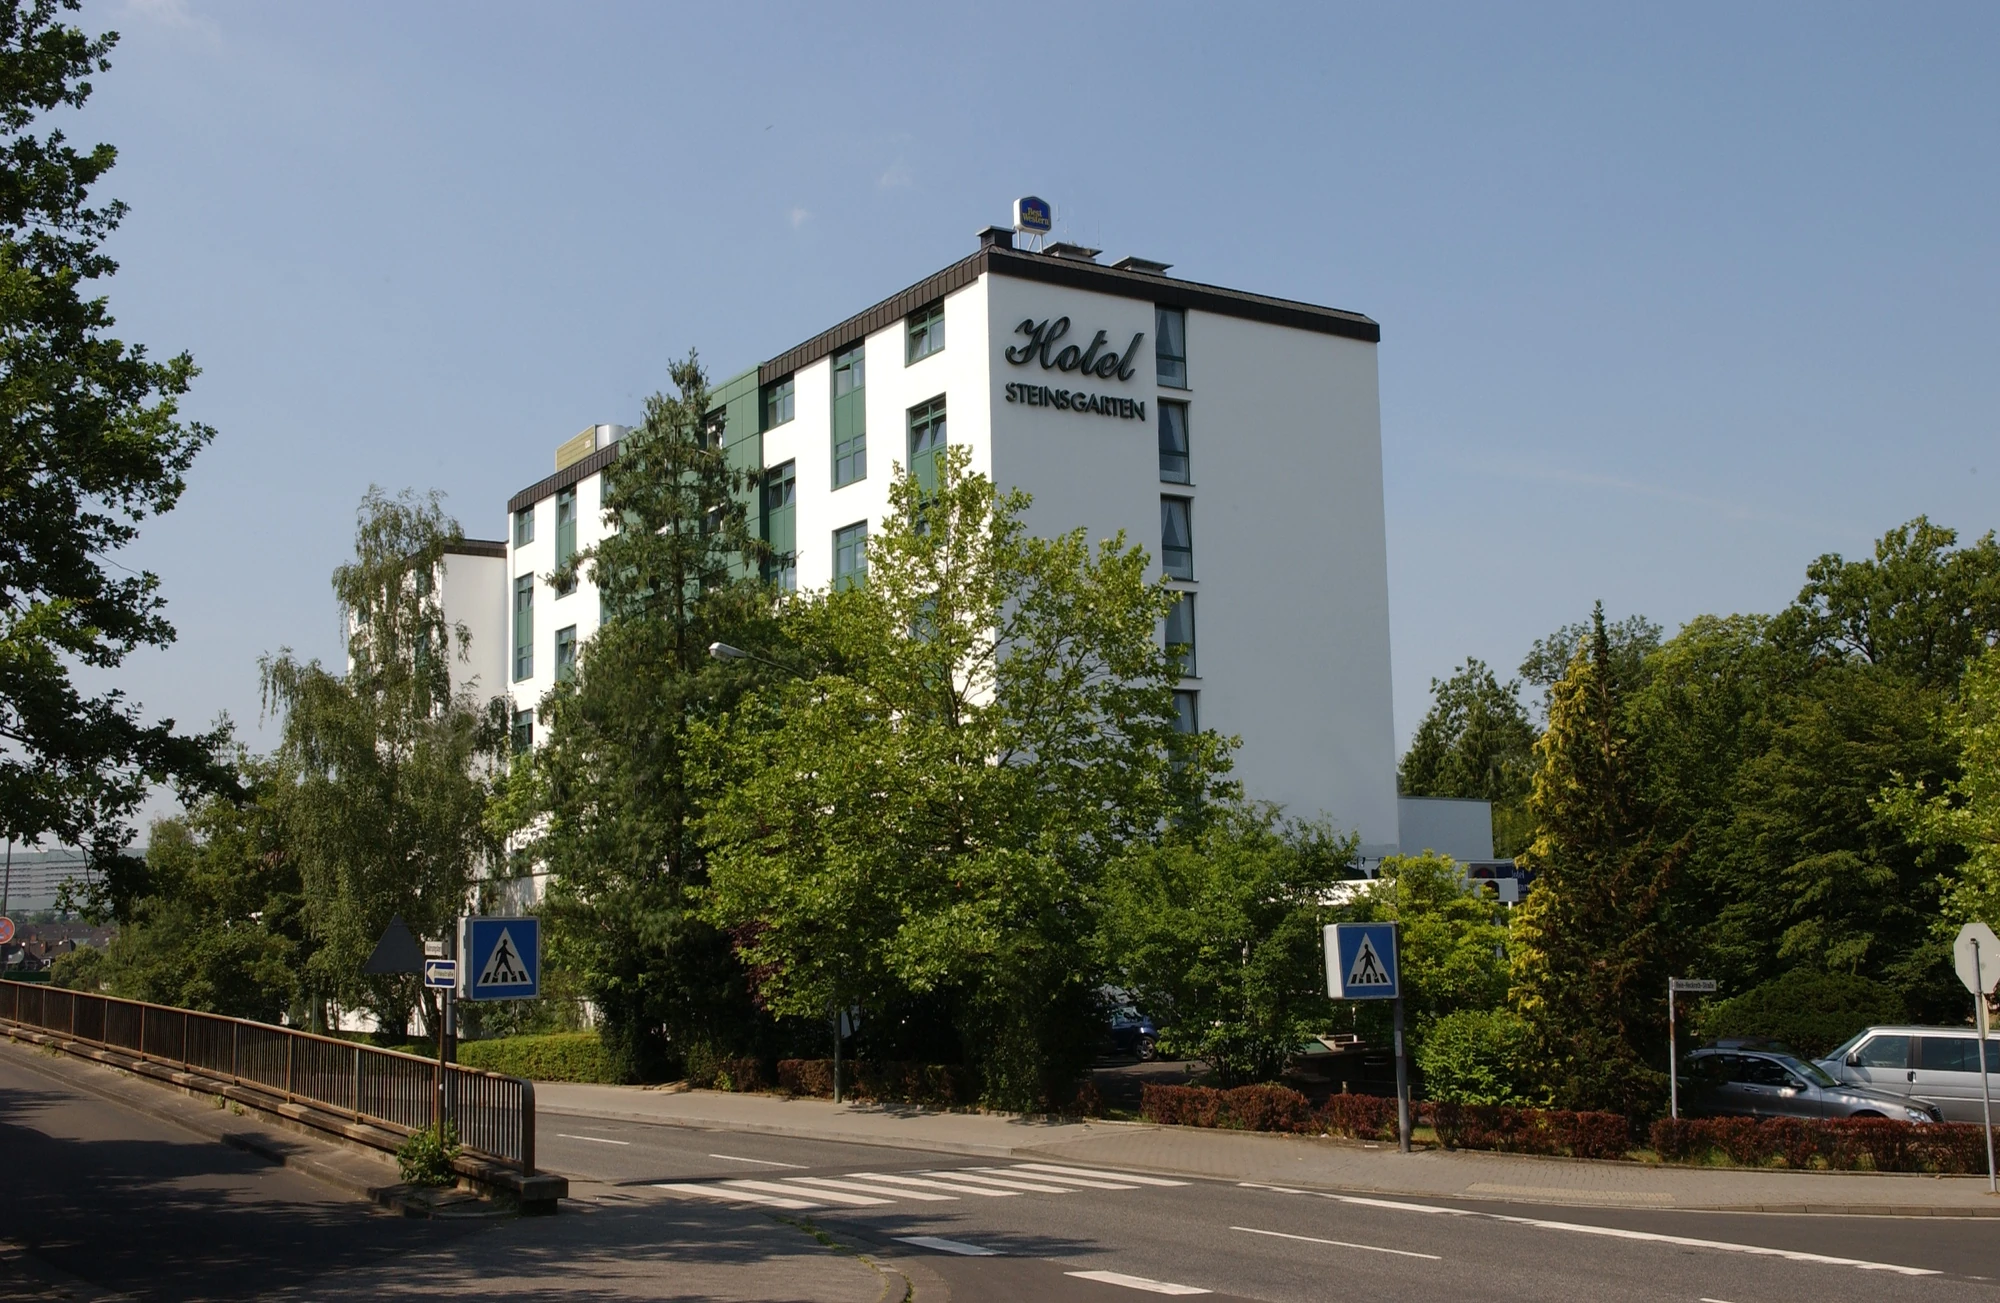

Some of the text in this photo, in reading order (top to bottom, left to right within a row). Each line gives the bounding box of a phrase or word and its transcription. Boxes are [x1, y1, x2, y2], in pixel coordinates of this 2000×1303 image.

[1022, 212, 1049, 226] Western
[1027, 207, 1043, 218] Best
[1004, 316, 1145, 382] Hotel
[1005, 382, 1146, 422] STEINSGARTEN
